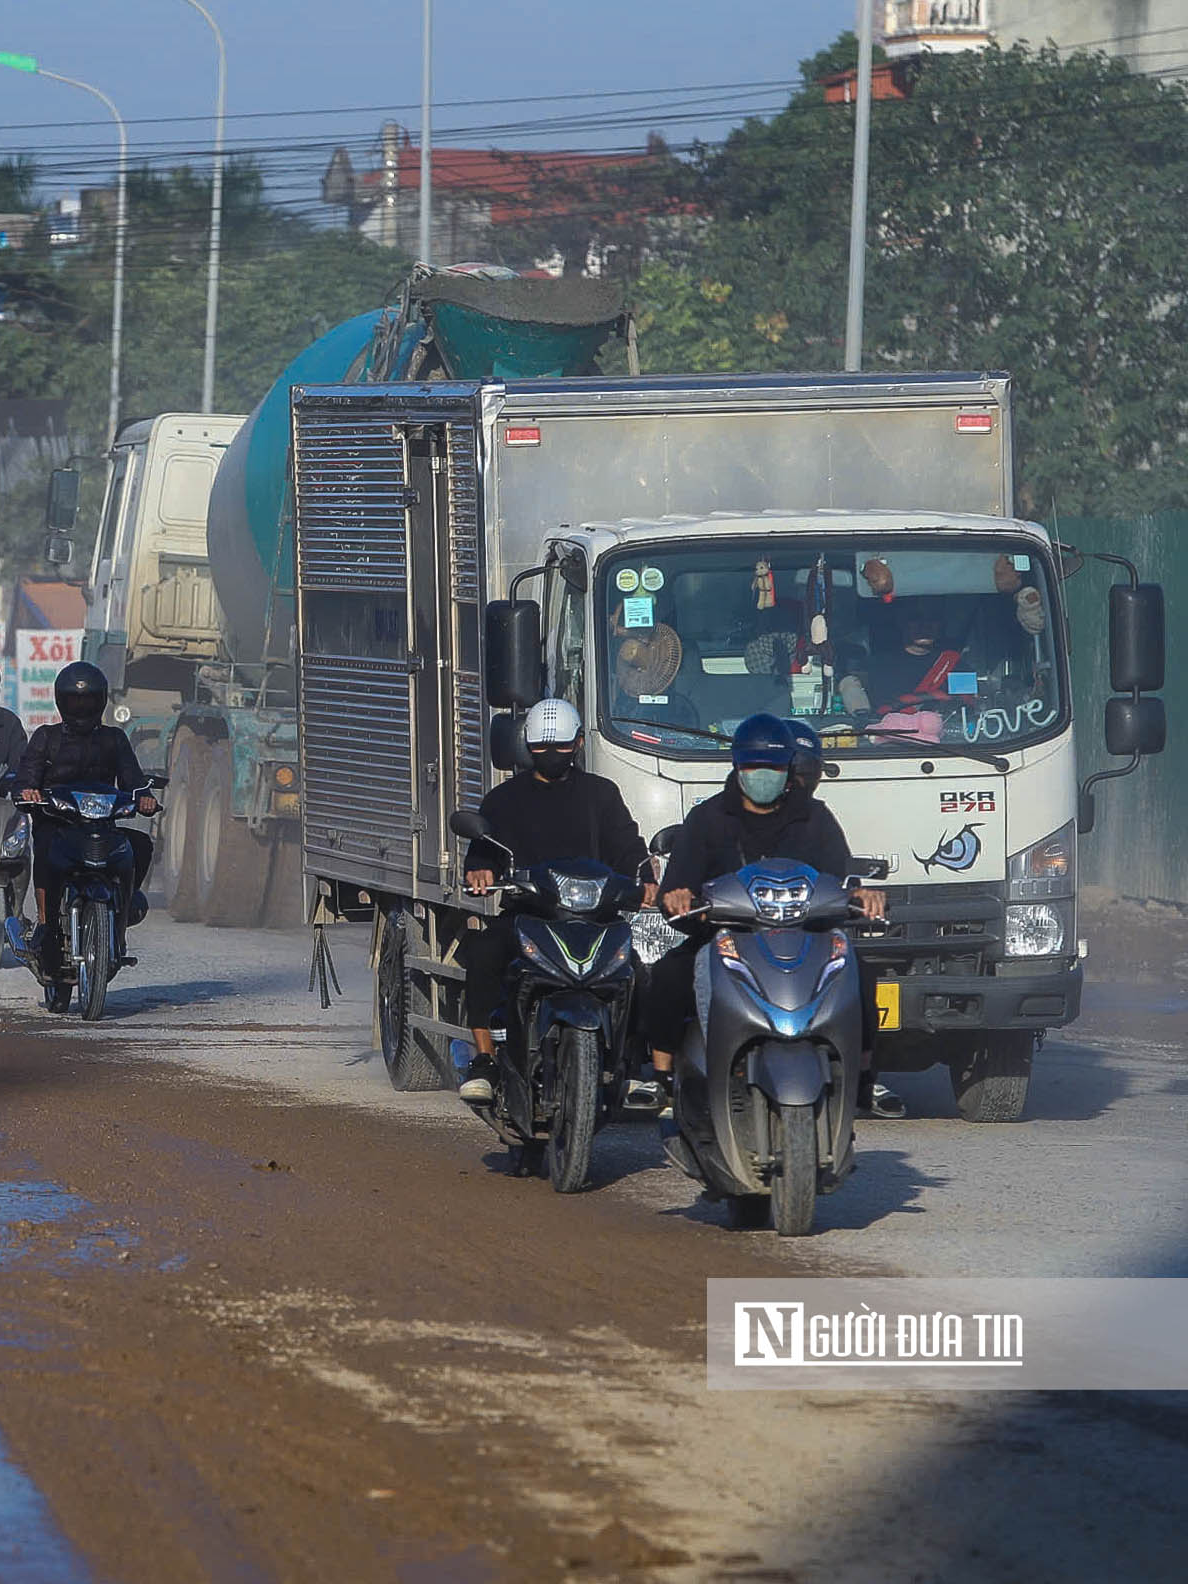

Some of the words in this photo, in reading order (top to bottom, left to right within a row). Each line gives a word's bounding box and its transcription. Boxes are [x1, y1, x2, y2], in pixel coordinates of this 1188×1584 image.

[29, 635, 74, 661] Xôi
[939, 791, 996, 802] QKR
[940, 802, 996, 813] 270
